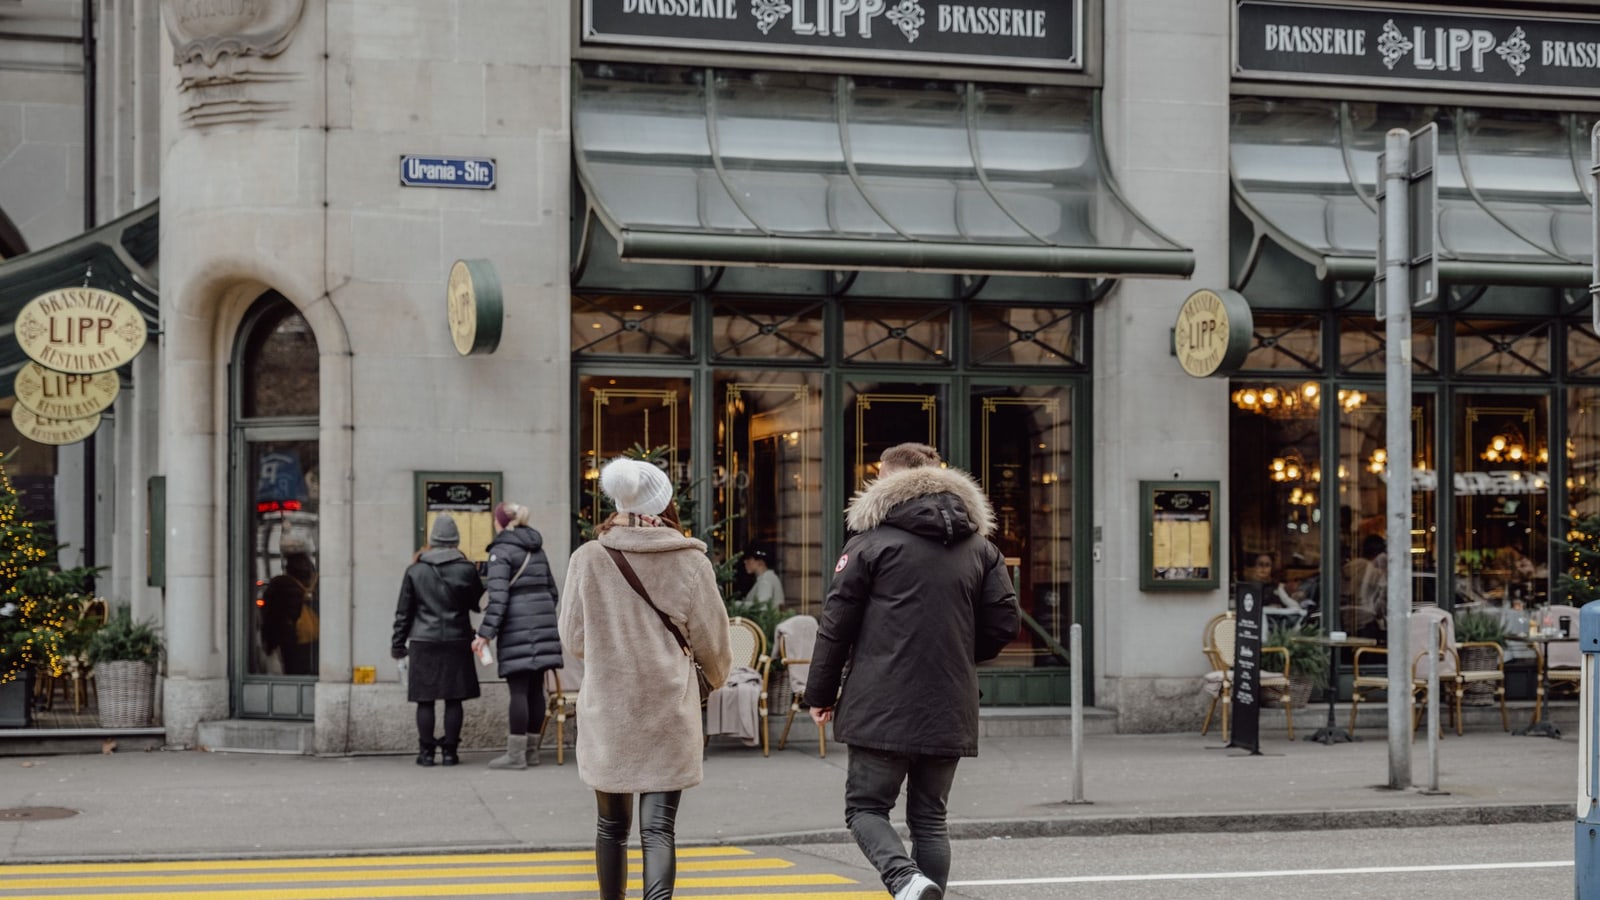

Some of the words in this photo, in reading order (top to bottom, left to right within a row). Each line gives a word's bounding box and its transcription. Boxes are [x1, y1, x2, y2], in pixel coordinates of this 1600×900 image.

[792, 0, 886, 38] LIPP
[938, 4, 1046, 38] BRASSERIE
[1265, 24, 1366, 56] BRASSERIE
[1413, 26, 1496, 72] LIPP
[38, 291, 123, 318] BRASSERIE
[50, 317, 113, 345] LIPP
[1189, 319, 1216, 350] LIPP
[40, 345, 120, 370] RESTAURANT
[42, 374, 93, 398] LIPP
